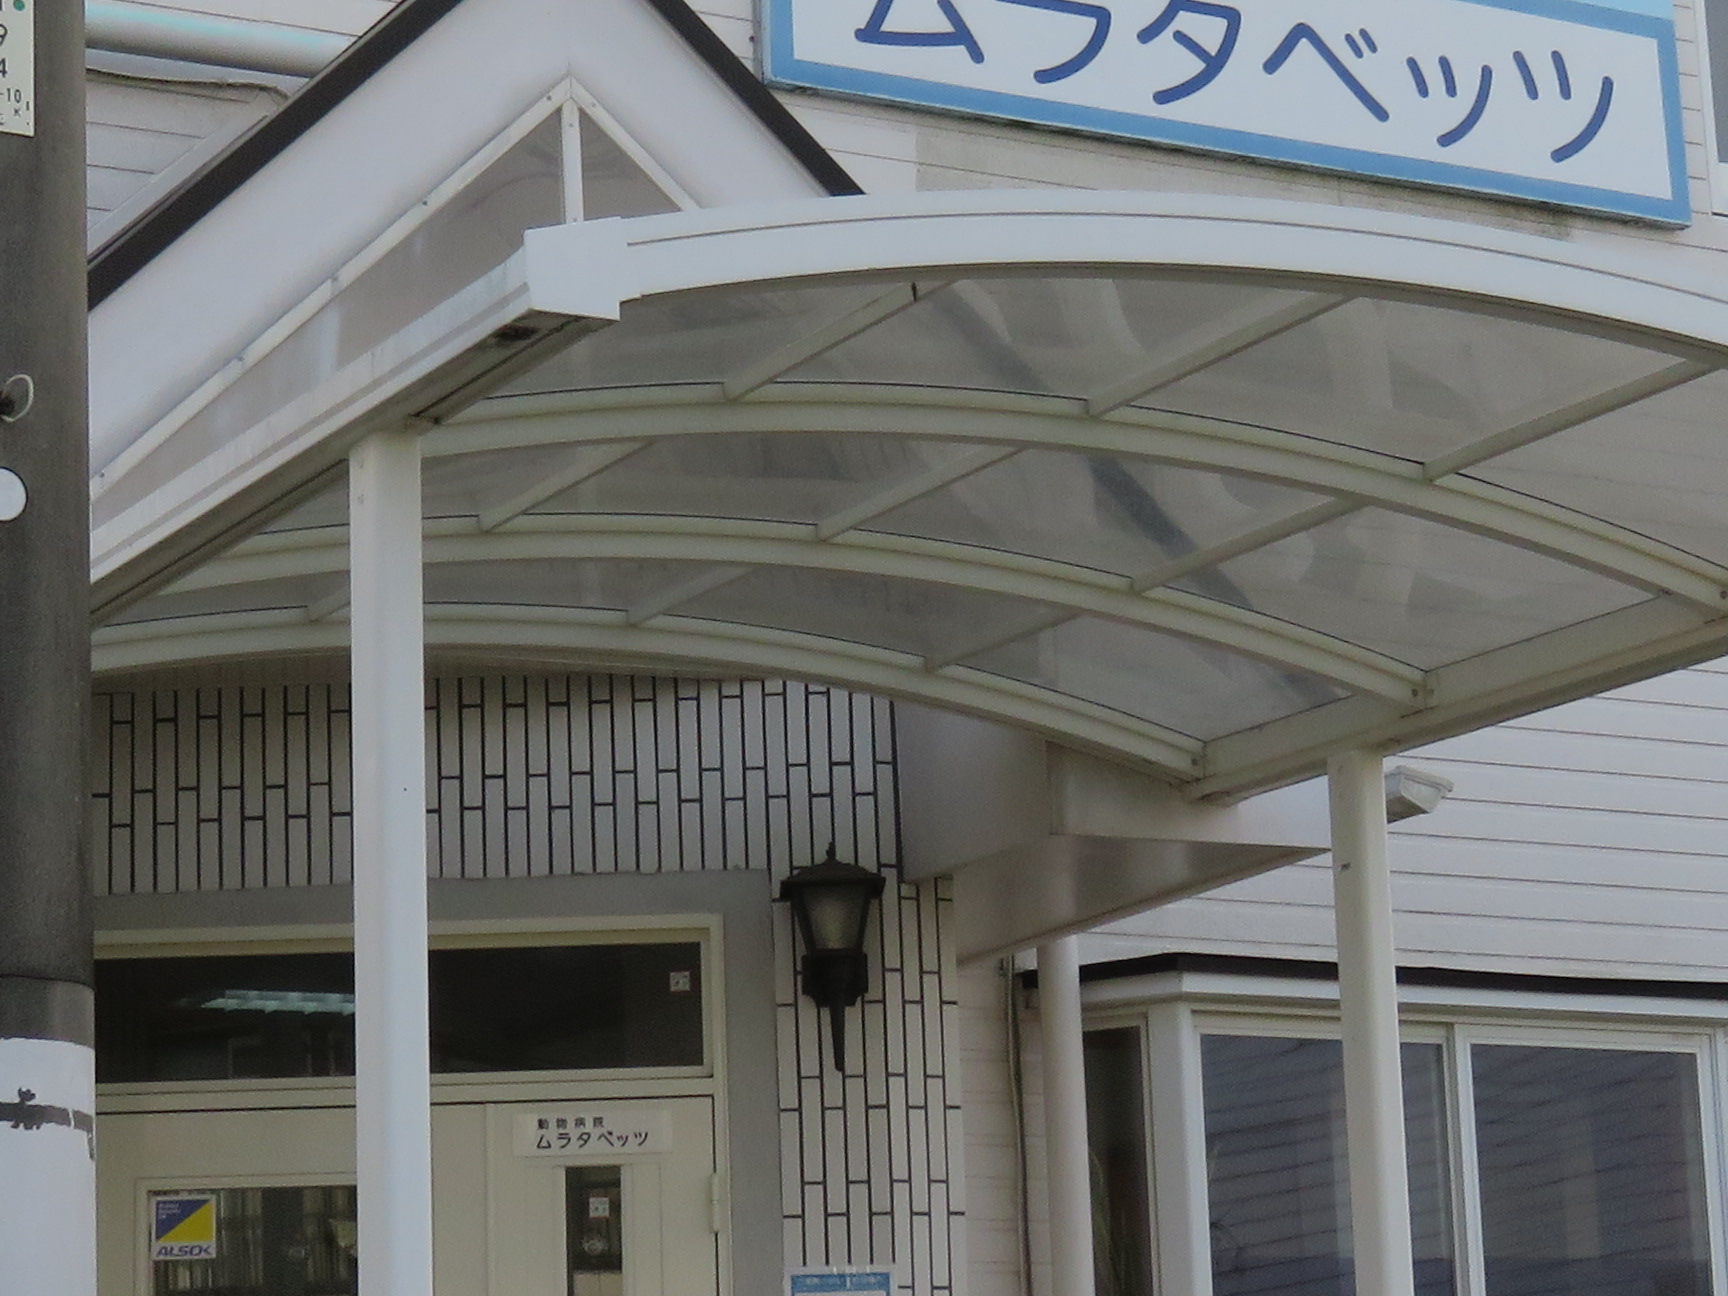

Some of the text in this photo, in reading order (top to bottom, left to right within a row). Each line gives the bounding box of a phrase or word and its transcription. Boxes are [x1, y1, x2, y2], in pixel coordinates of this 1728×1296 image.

[537, 1131, 649, 1150] ムラタベッツ
[155, 1245, 213, 1257] ALSOK
